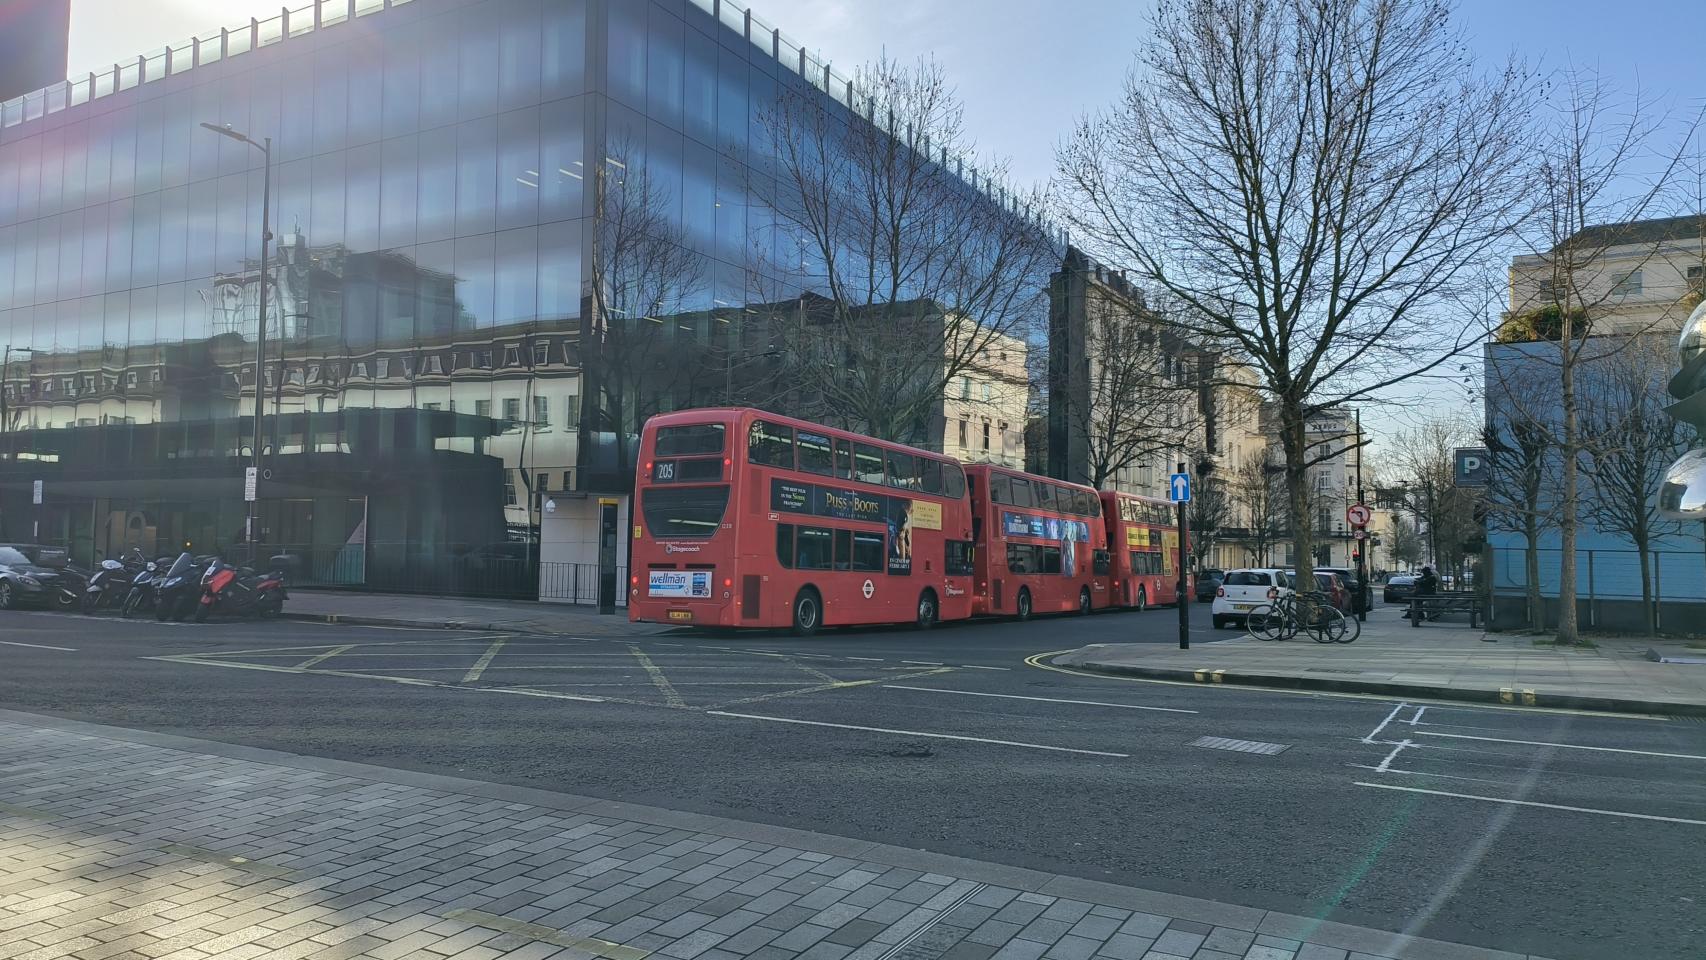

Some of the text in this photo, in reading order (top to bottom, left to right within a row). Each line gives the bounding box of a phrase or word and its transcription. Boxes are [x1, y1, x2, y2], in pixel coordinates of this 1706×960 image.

[658, 463, 674, 479] 205
[1464, 456, 1480, 474] P
[672, 545, 700, 553] Stagecoach
[651, 573, 686, 584] wellman
